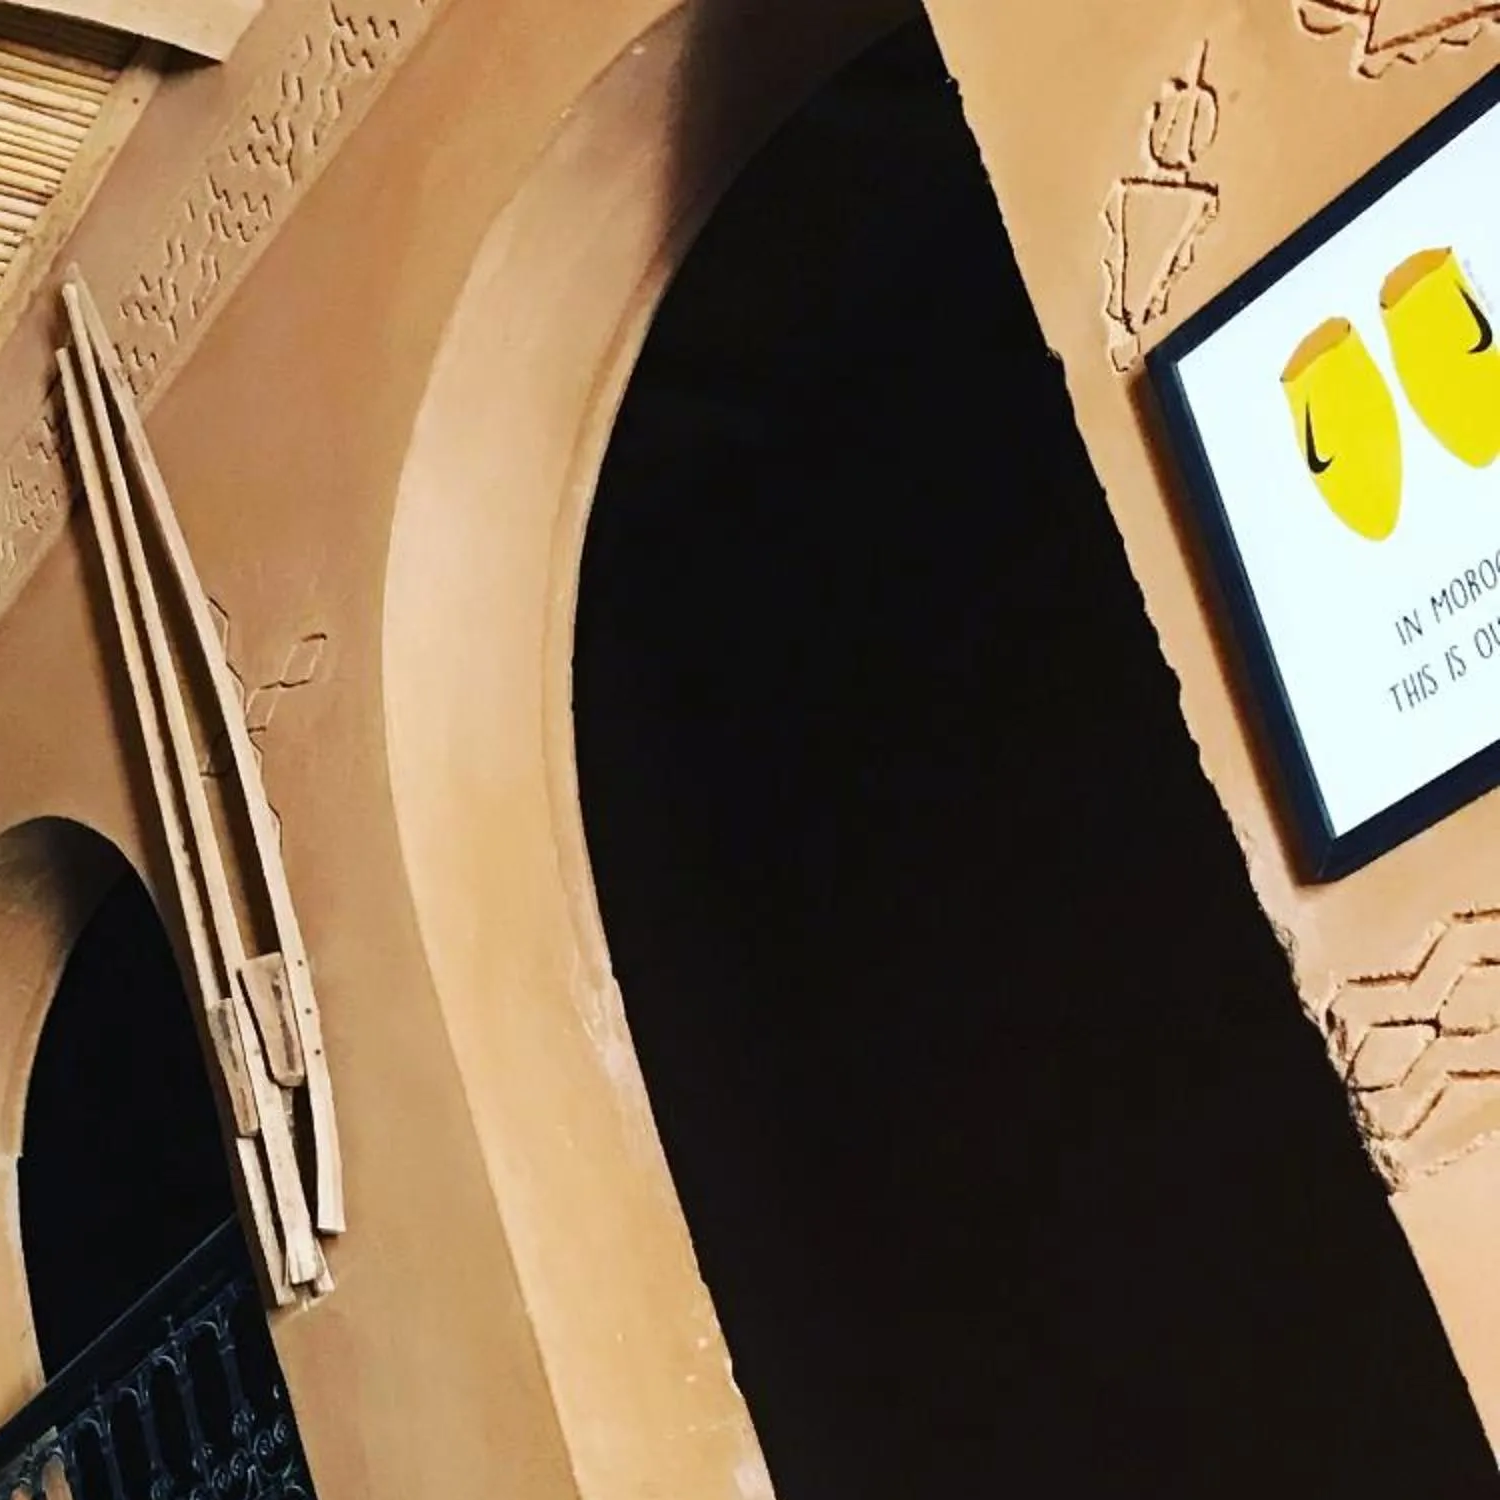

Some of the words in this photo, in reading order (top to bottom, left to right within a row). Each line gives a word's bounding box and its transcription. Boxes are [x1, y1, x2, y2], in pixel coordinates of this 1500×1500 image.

[1395, 608, 1423, 645] IN
[1389, 663, 1439, 712] THIS
[1444, 644, 1467, 681] IS
